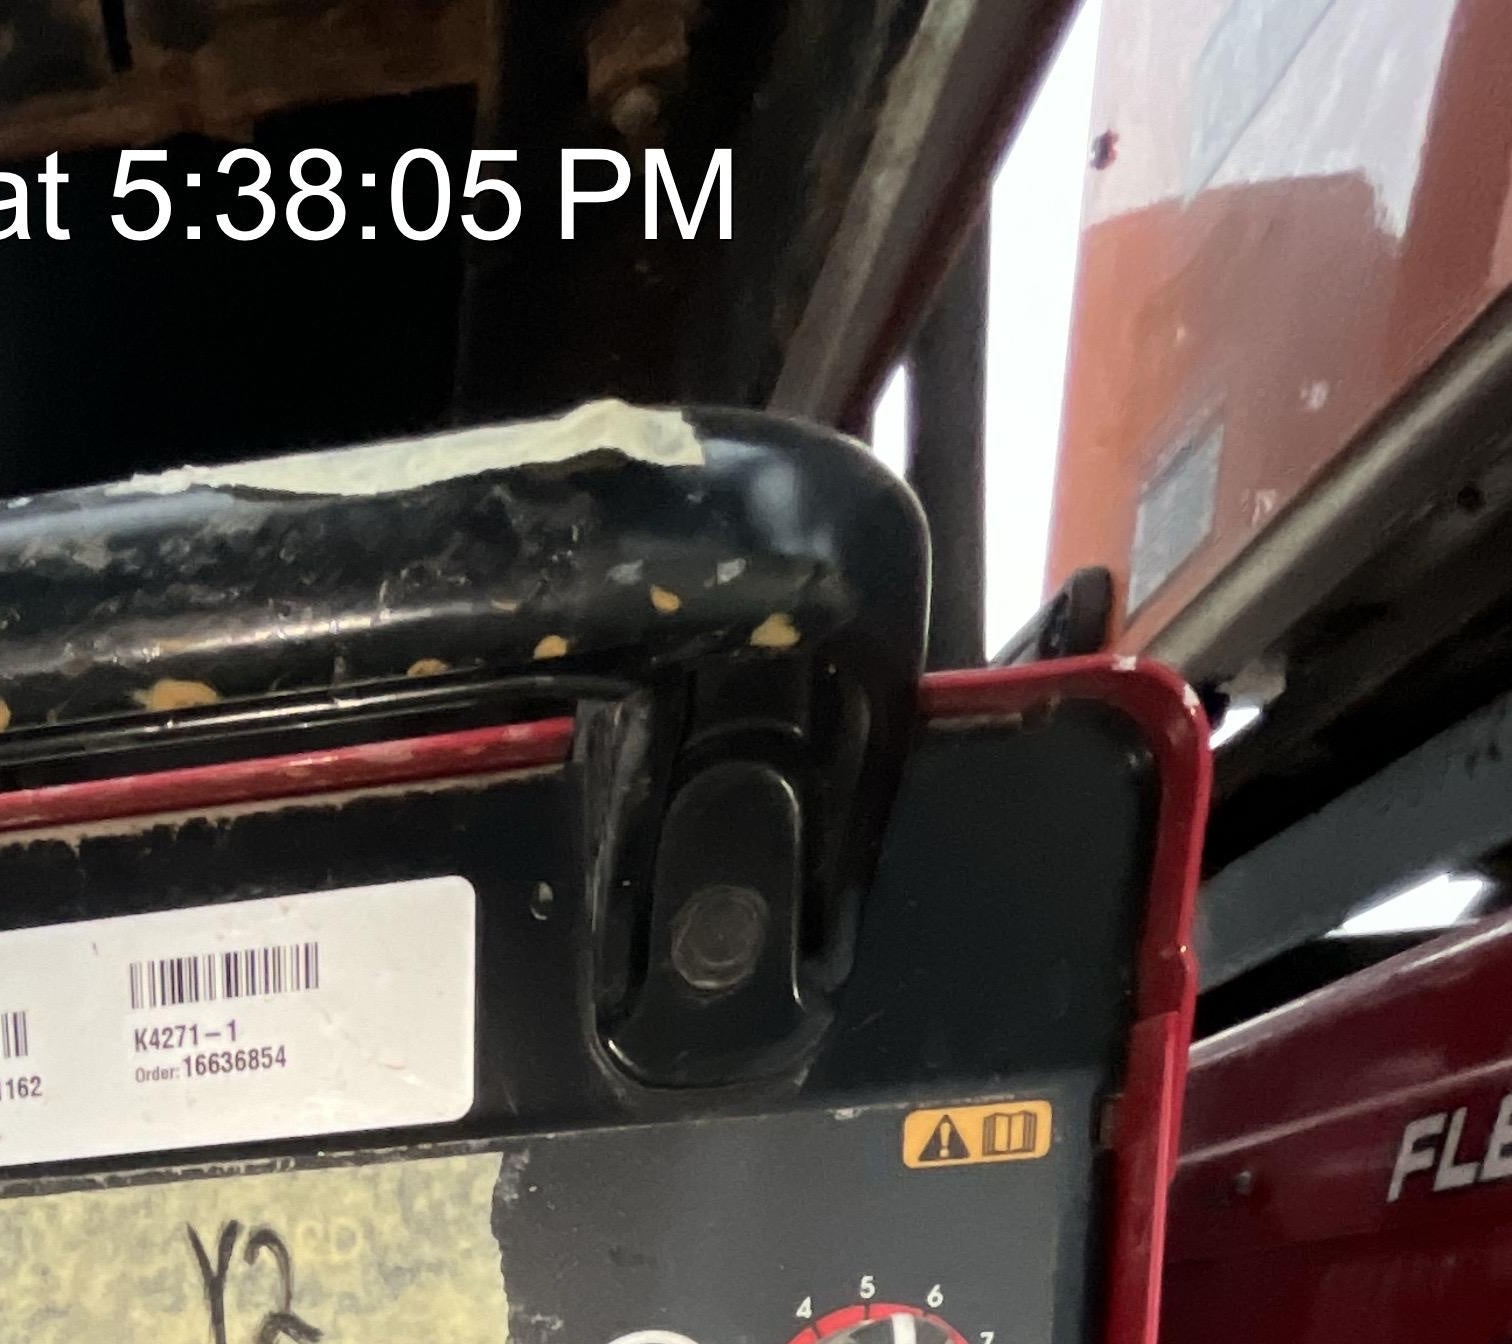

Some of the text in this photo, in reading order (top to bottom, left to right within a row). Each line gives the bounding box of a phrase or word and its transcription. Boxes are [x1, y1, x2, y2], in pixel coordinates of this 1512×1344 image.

[134, 1019, 238, 1053] K4271-1
[135, 1044, 288, 1084] Order: 16636854
[859, 1275, 876, 1299] 5
[926, 1284, 944, 1308] 6
[795, 1296, 813, 1319] 4
